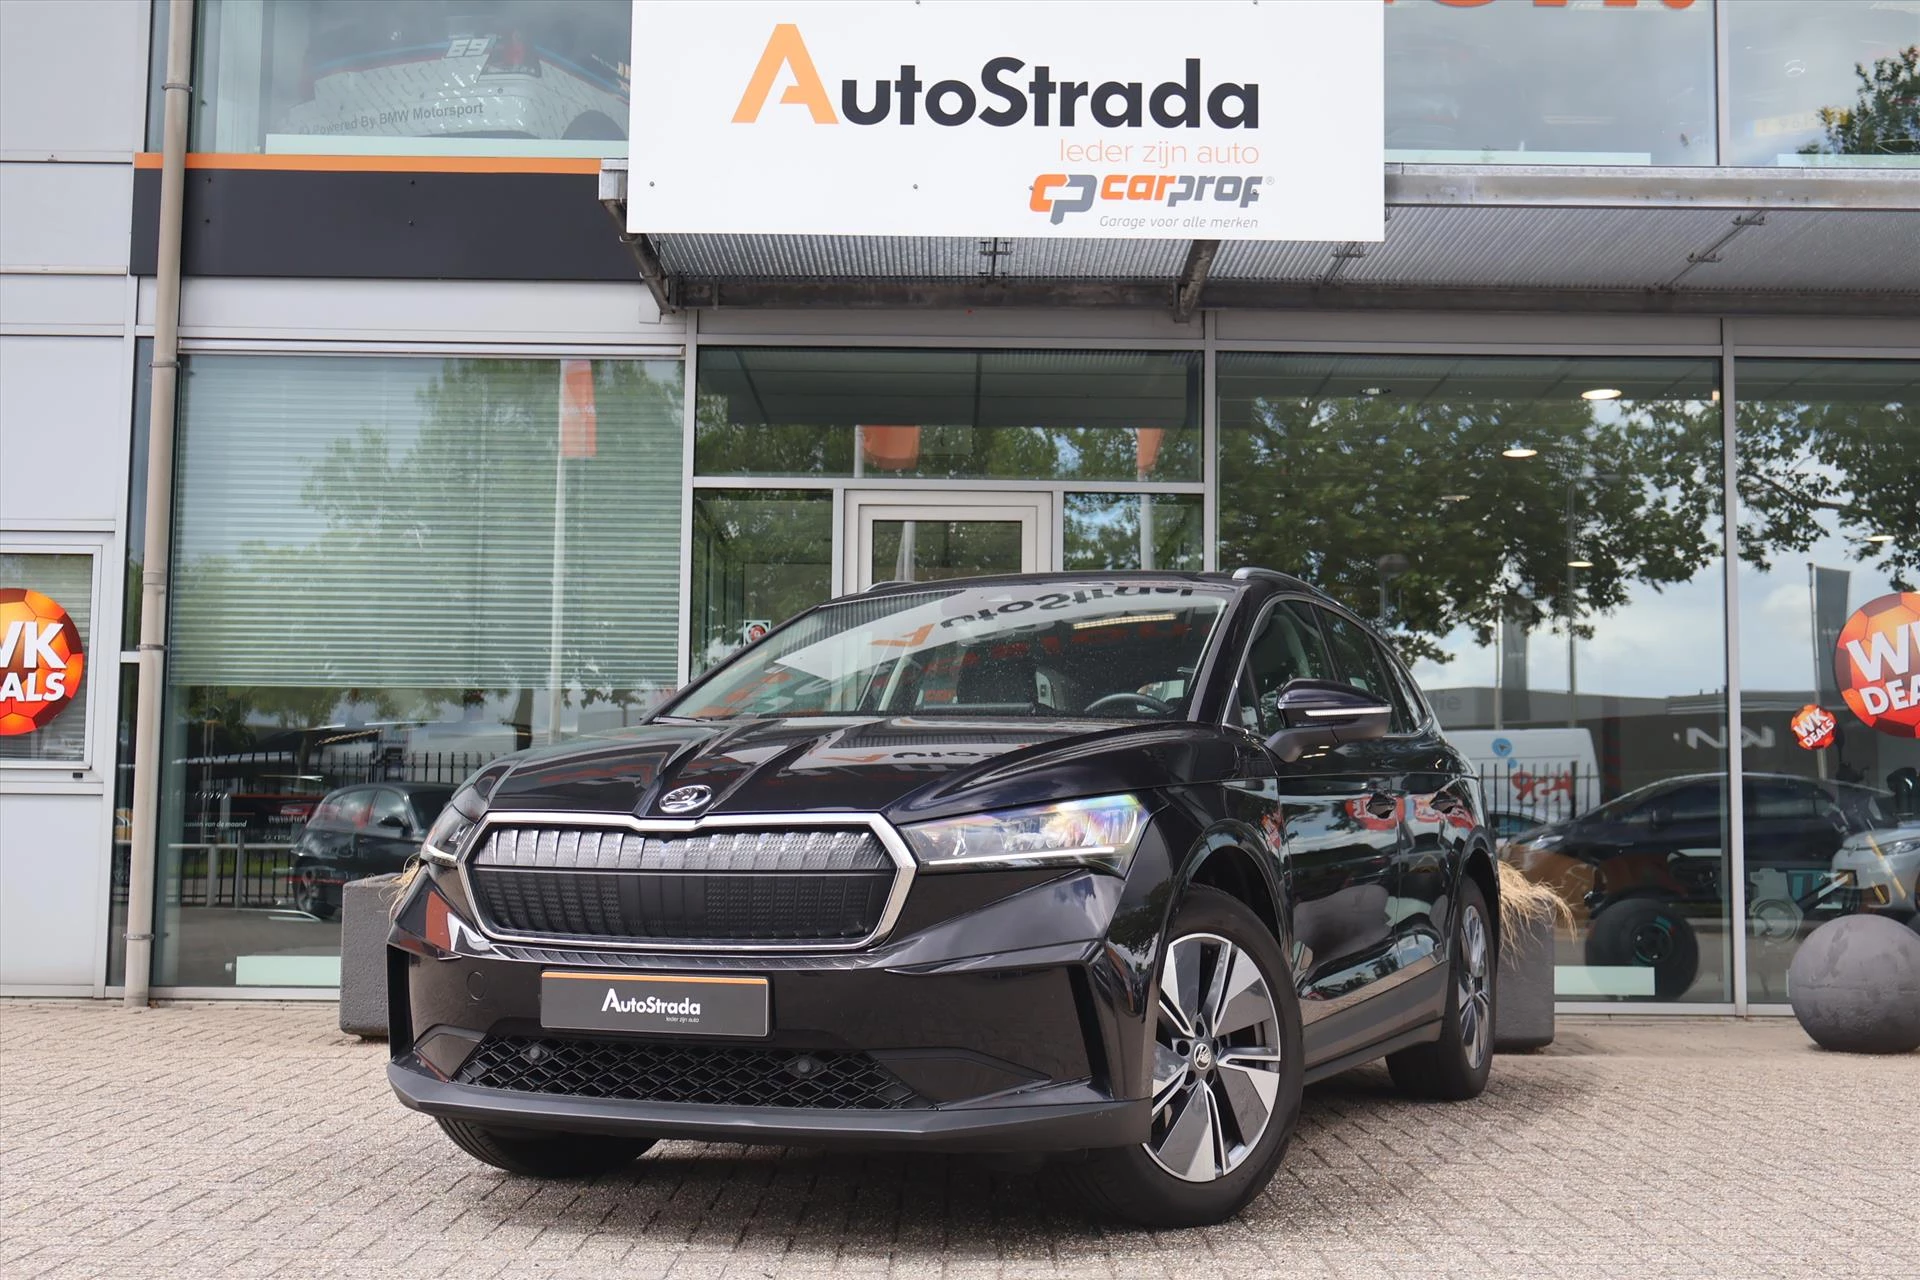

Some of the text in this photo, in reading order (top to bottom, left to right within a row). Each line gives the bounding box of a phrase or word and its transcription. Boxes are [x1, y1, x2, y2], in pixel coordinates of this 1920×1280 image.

[731, 23, 1260, 130] AutoStrada
[360, 114, 375, 130] By
[379, 109, 409, 126] BMW
[412, 102, 484, 120] Motorsport
[1060, 138, 1260, 169] Ieder zijn auto
[1100, 174, 1263, 208] carprof
[1099, 215, 1258, 230] Garage voor alle merken
[1793, 708, 1828, 738] WK
[1803, 719, 1834, 747] DEALS
[601, 988, 701, 1015] AutoStrada
